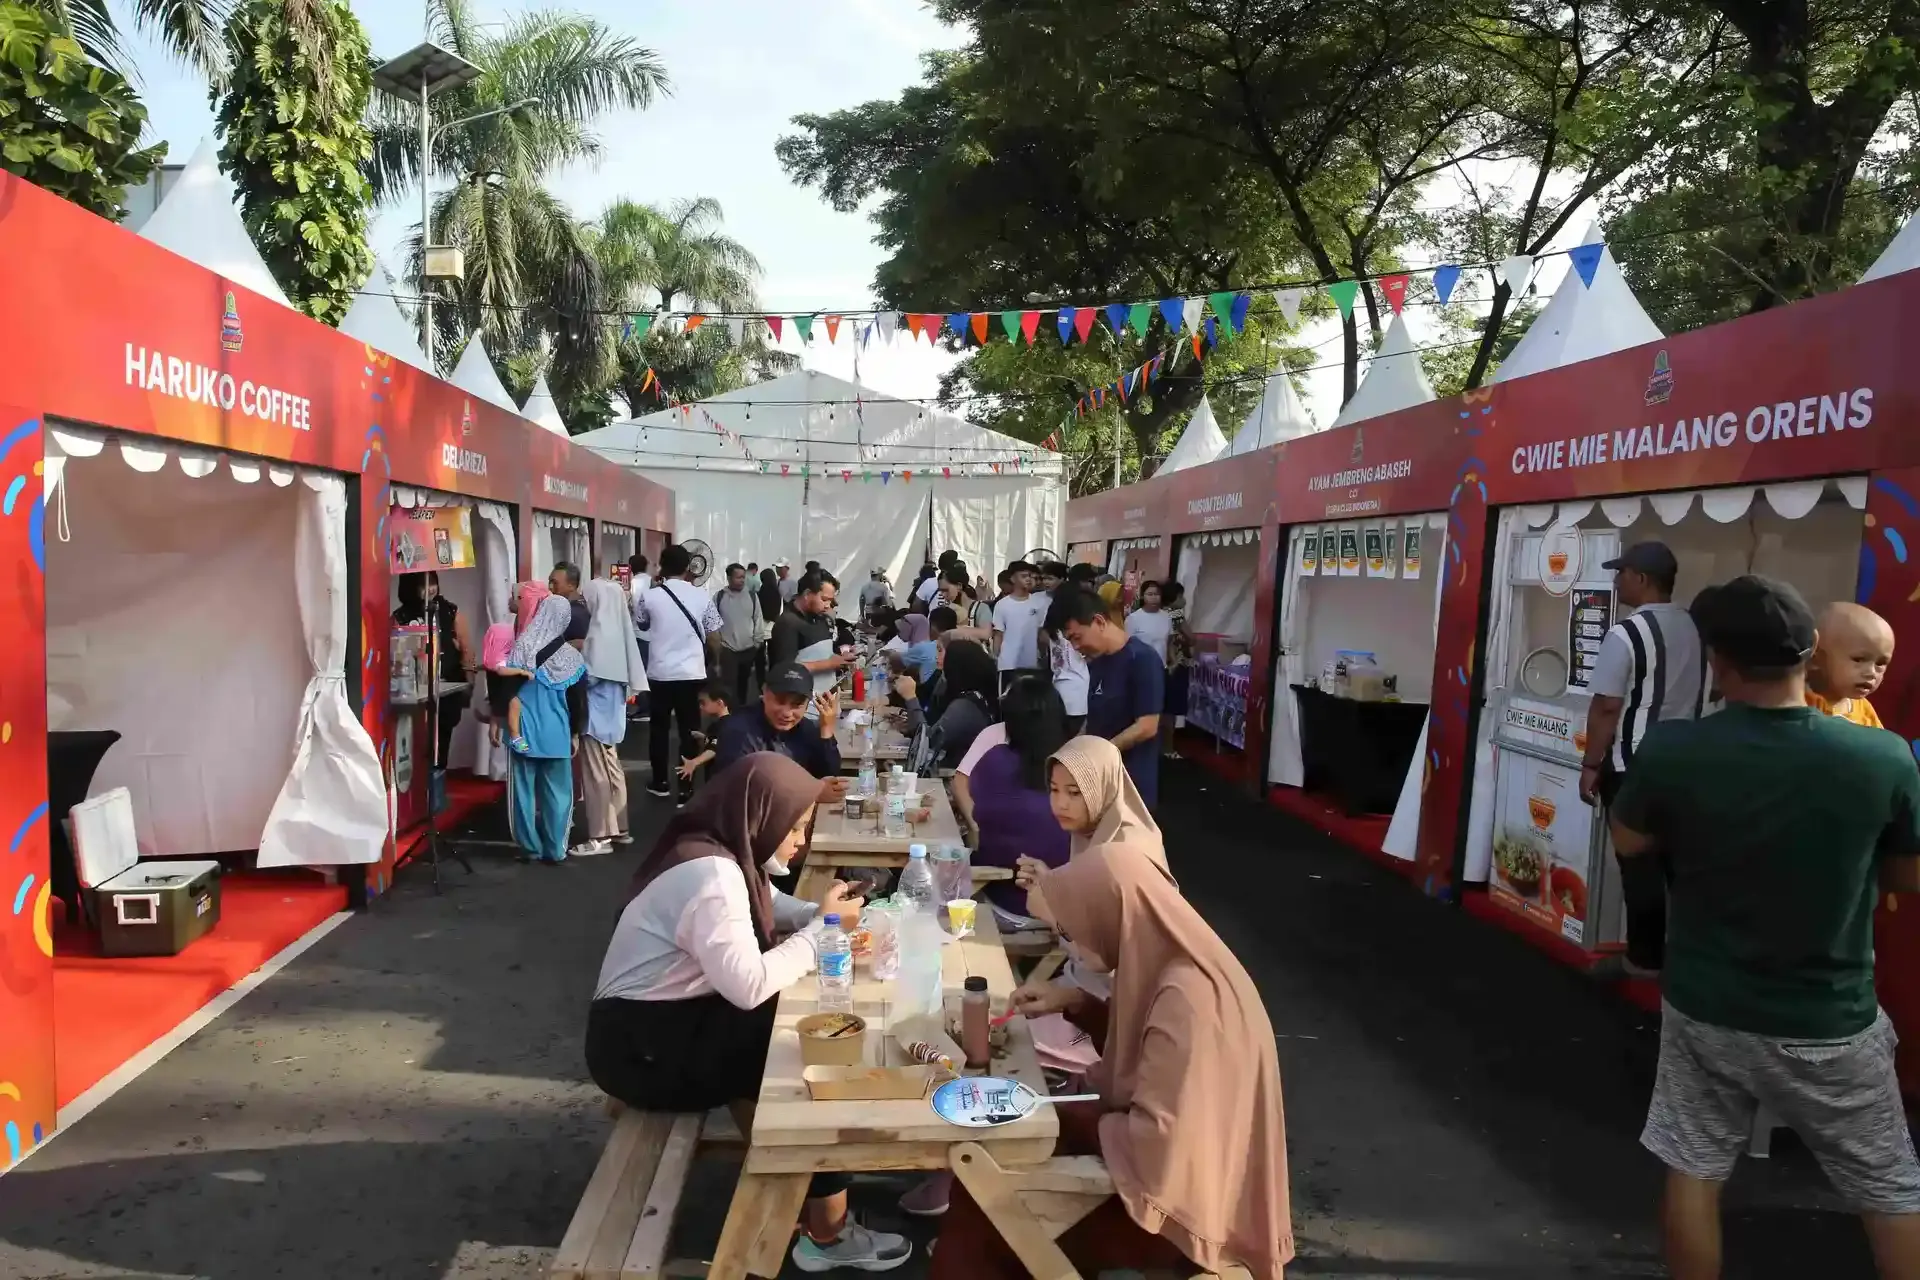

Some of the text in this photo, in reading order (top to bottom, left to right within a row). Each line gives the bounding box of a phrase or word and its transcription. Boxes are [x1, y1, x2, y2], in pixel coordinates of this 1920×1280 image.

[125, 342, 311, 431] HARUKO COFFEE
[1512, 387, 1874, 474] CWIE MIE MALANG ORENS
[442, 442, 487, 477] DELARIEZA
[1308, 459, 1411, 491] AYAM JEMBRENG ABASEH
[1506, 709, 1568, 736] CWIE MIE MALANG
